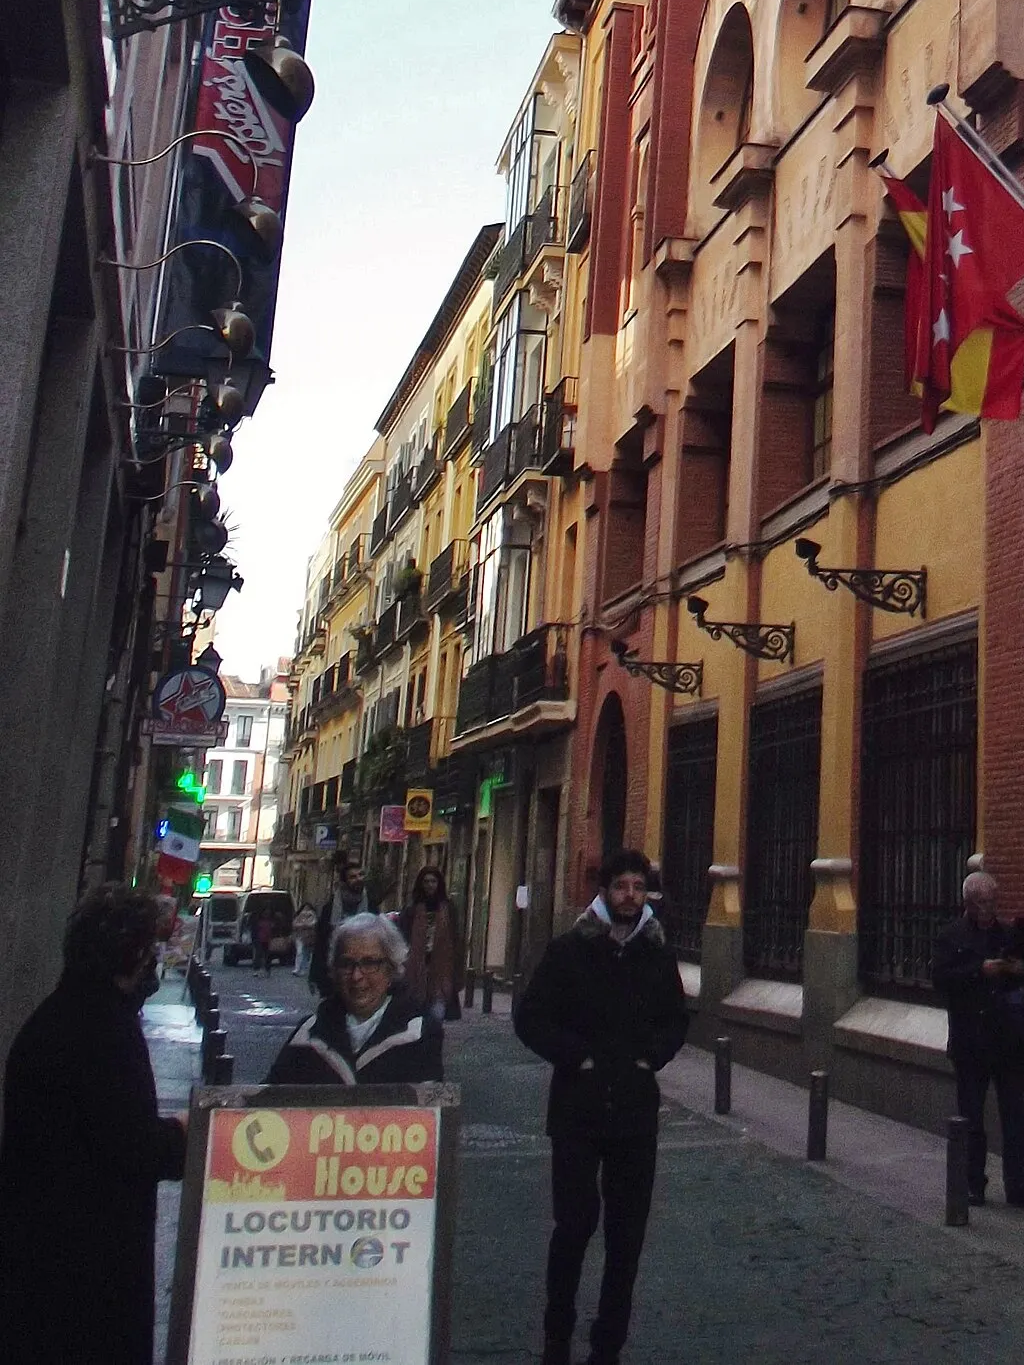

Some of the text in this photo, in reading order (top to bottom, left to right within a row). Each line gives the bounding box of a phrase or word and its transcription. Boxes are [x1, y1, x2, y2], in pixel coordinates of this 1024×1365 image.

[308, 1113, 428, 1154] Phono
[314, 1156, 429, 1197] House
[224, 1208, 412, 1234] LOCUTORIO
